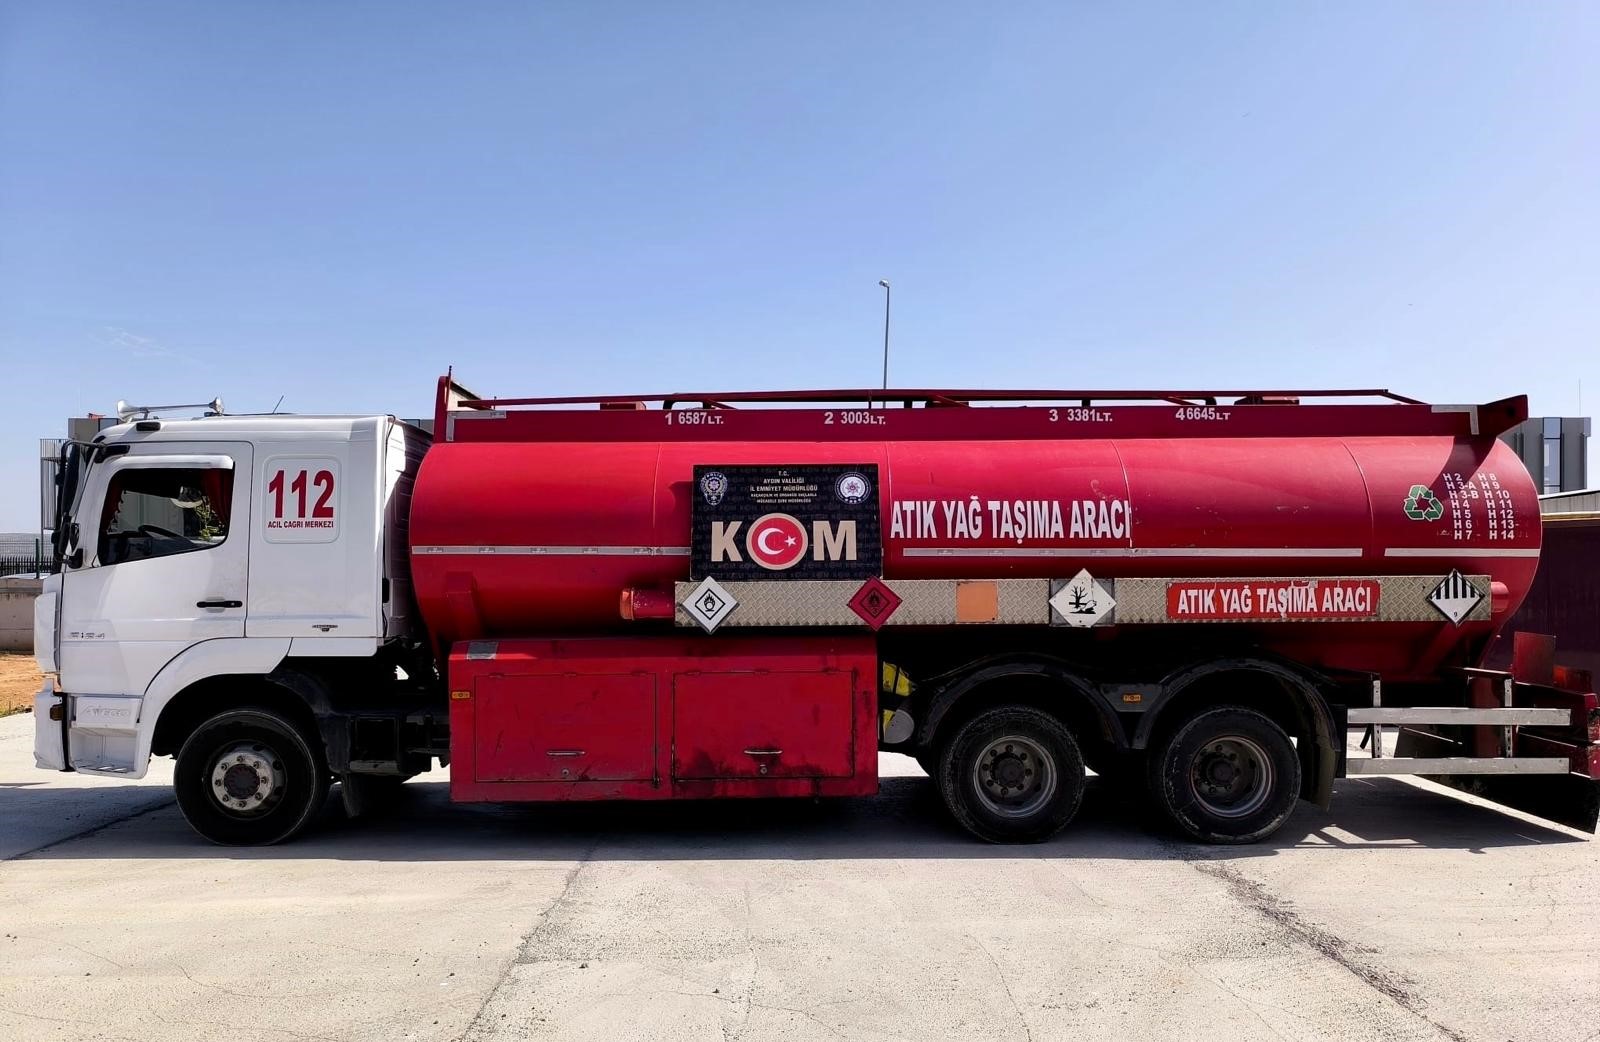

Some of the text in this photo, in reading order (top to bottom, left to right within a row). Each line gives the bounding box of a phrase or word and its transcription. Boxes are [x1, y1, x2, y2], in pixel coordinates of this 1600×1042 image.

[665, 412, 672, 425] 1
[824, 411, 834, 425] 2
[1049, 409, 1058, 422] 3
[1175, 407, 1185, 420] 4
[1443, 473, 1462, 481] H 2
[1477, 473, 1487, 481] H
[1446, 481, 1477, 490] H 3-A
[1481, 481, 1500, 490] H 9
[269, 470, 334, 518] 112
[1449, 490, 1479, 499] H 3-B
[1483, 490, 1510, 499] H 10
[1451, 499, 1470, 509] H 4
[1486, 499, 1513, 509] H 11
[1452, 509, 1472, 519] H 5
[1488, 509, 1514, 519] H 12
[890, 496, 1131, 544] ATIK YAĞ TAŞIMA ARACI
[1453, 519, 1472, 529] H 6
[1488, 519, 1515, 529] H 13
[1454, 530, 1473, 540] H 7
[1489, 530, 1515, 540] H 14
[1178, 585, 1371, 617] ATIK YAĞ TAŞIMA ARACI
